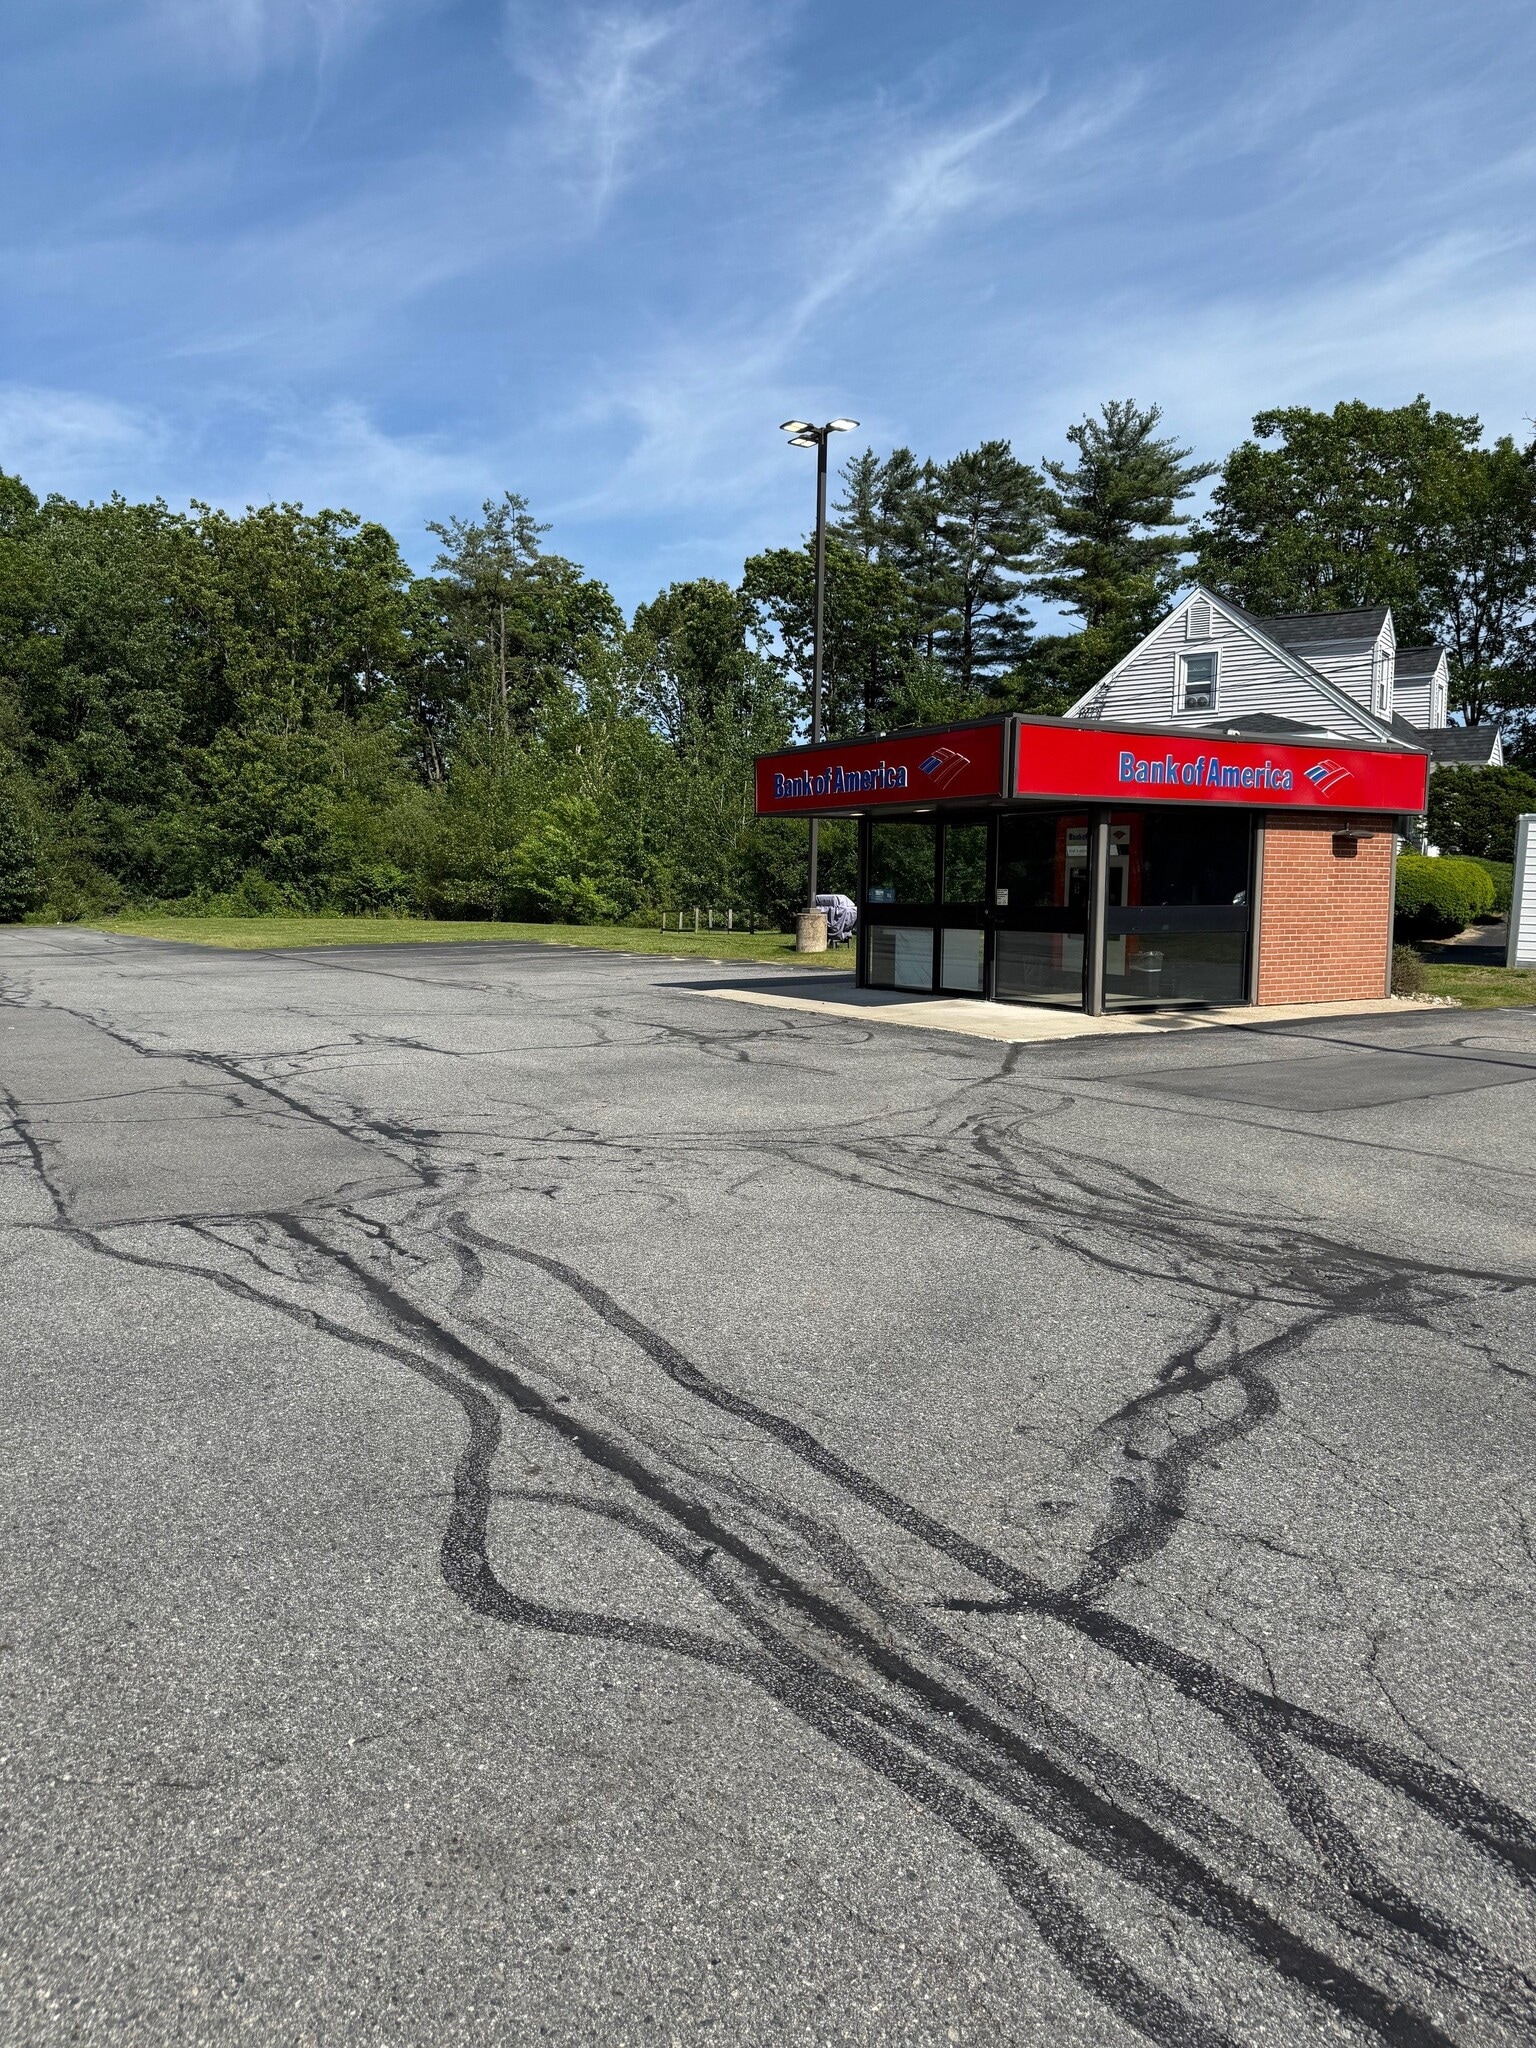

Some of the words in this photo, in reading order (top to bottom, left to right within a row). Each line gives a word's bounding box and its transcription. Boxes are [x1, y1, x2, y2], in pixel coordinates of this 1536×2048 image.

[774, 770, 814, 799] Bank
[815, 767, 833, 795] of
[834, 761, 908, 793] America
[1119, 751, 1180, 784] Bank
[1182, 756, 1205, 786] of
[1206, 757, 1293, 790] America
